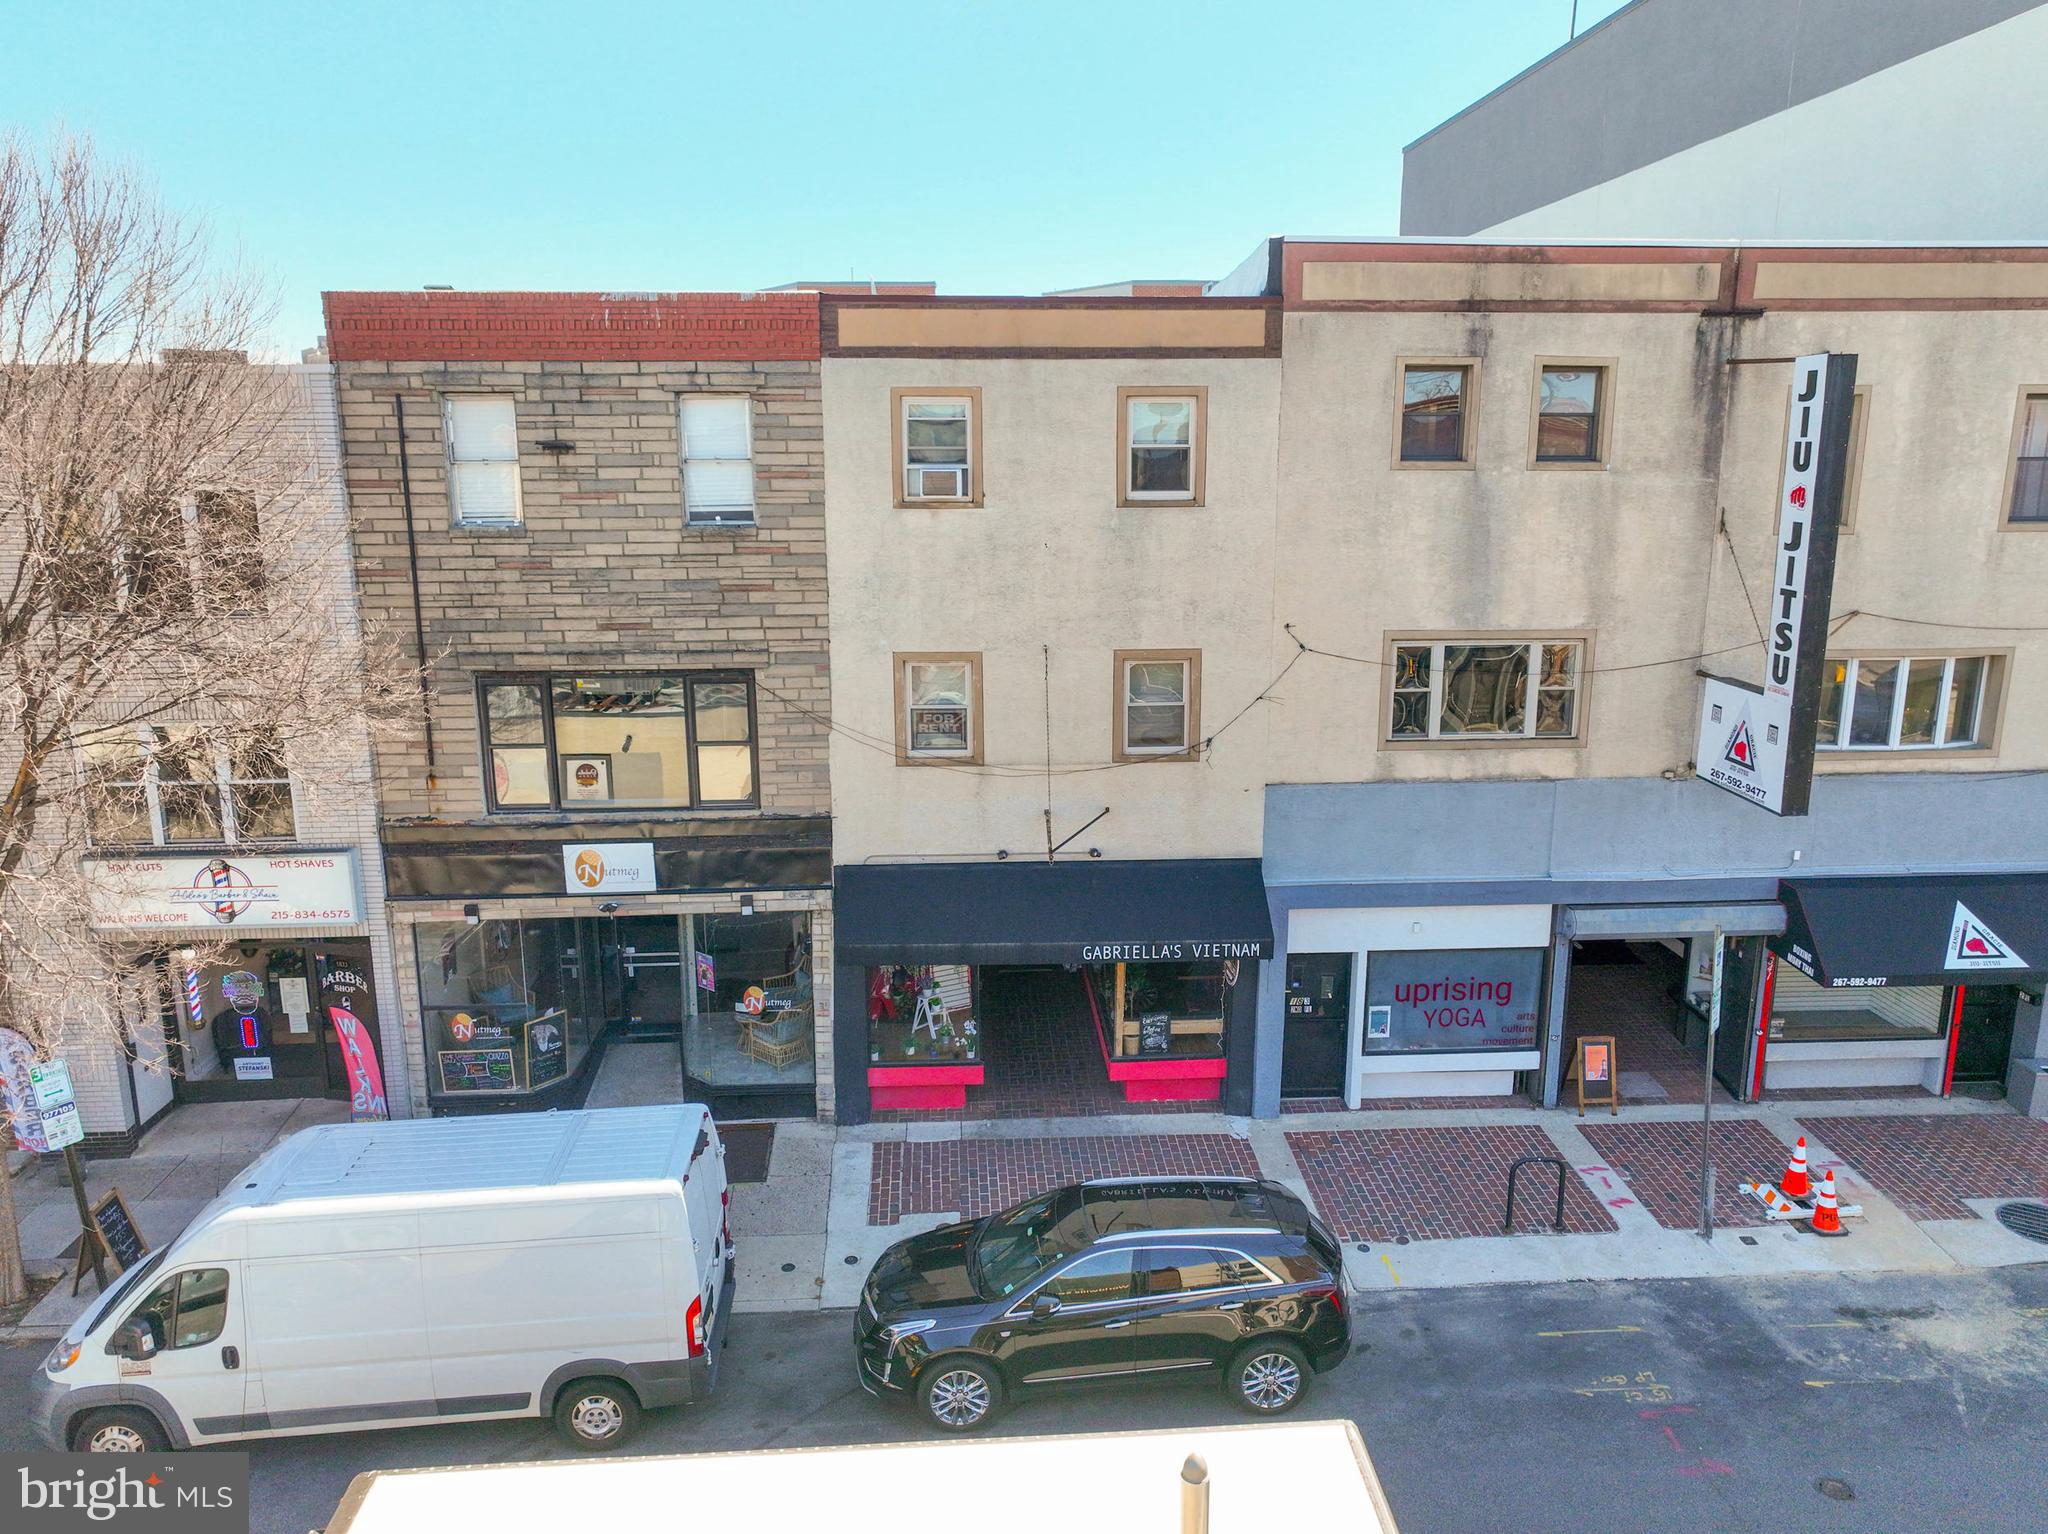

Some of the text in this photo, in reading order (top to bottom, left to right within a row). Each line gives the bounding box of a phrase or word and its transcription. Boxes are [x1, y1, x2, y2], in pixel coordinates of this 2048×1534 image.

[1793, 370, 1818, 472] JIU
[1772, 522, 1803, 685] JITSU
[919, 714, 960, 733] FOR RENT
[1710, 768, 1767, 800] 267-592-9477
[135, 863, 163, 871] CUTS
[269, 859, 335, 869] HOT SHAVES
[578, 861, 640, 883] Nutmeg
[144, 913, 190, 923] WELCOME
[271, 909, 351, 920] 215-834-6575
[1982, 927, 2003, 949] GRACIE
[1083, 943, 1261, 960] GABRIELLA'S VIETNAM
[1793, 944, 1812, 963] BOXING
[1787, 952, 1801, 969] MUAY
[1801, 962, 1815, 977] THAI
[322, 970, 369, 994] BARBER
[334, 984, 356, 993] SHOP
[1833, 977, 1887, 987] 267-592-9477
[746, 992, 792, 1011] Nutmeg
[1395, 976, 1512, 1008] uprising
[1424, 1008, 1486, 1029] YOGA
[1517, 1012, 1536, 1021] arts
[453, 1019, 502, 1039] Nutmeg
[1501, 1025, 1536, 1033] culture
[1482, 1037, 1534, 1046] movement
[43, 1104, 75, 1120] 977105
